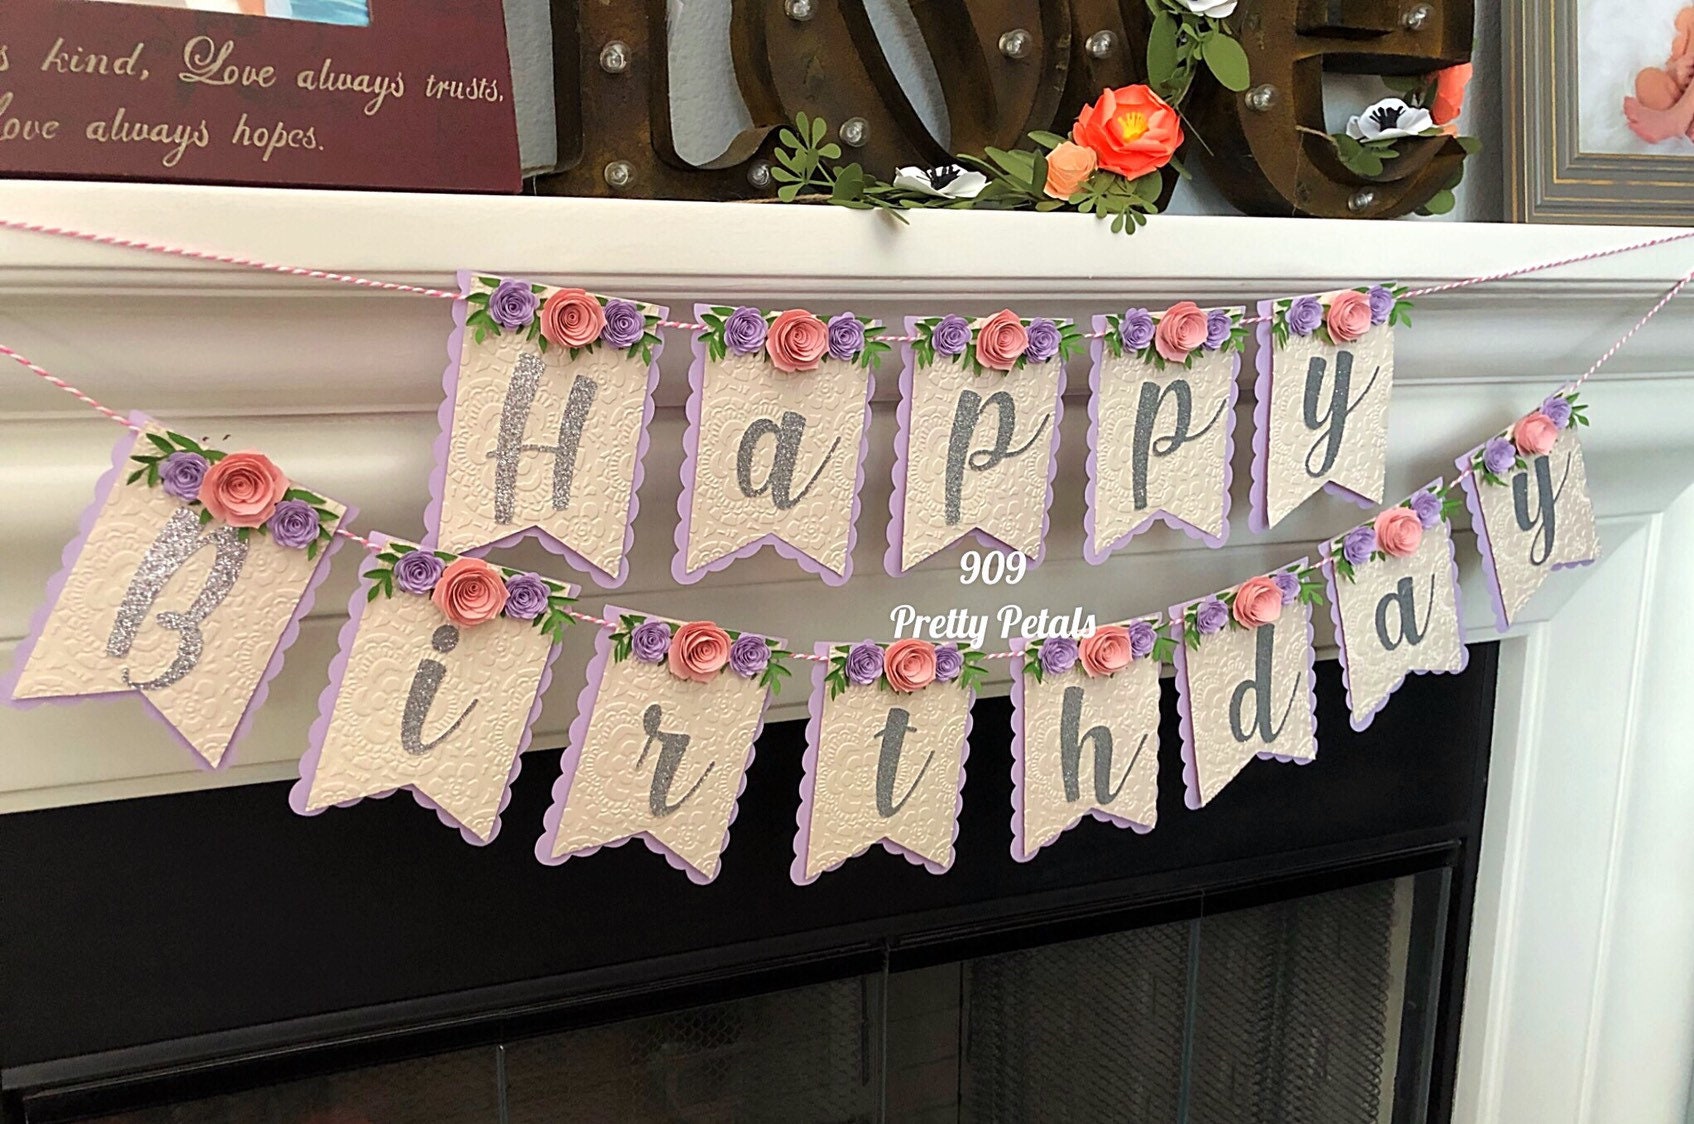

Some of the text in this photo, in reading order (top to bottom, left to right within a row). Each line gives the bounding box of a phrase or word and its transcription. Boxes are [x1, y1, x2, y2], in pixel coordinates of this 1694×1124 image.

[41, 36, 150, 80] kind,
[179, 35, 276, 86] Love
[297, 59, 404, 116] always
[426, 74, 505, 103] trusts,
[0, 91, 324, 167] ove always hopes.
